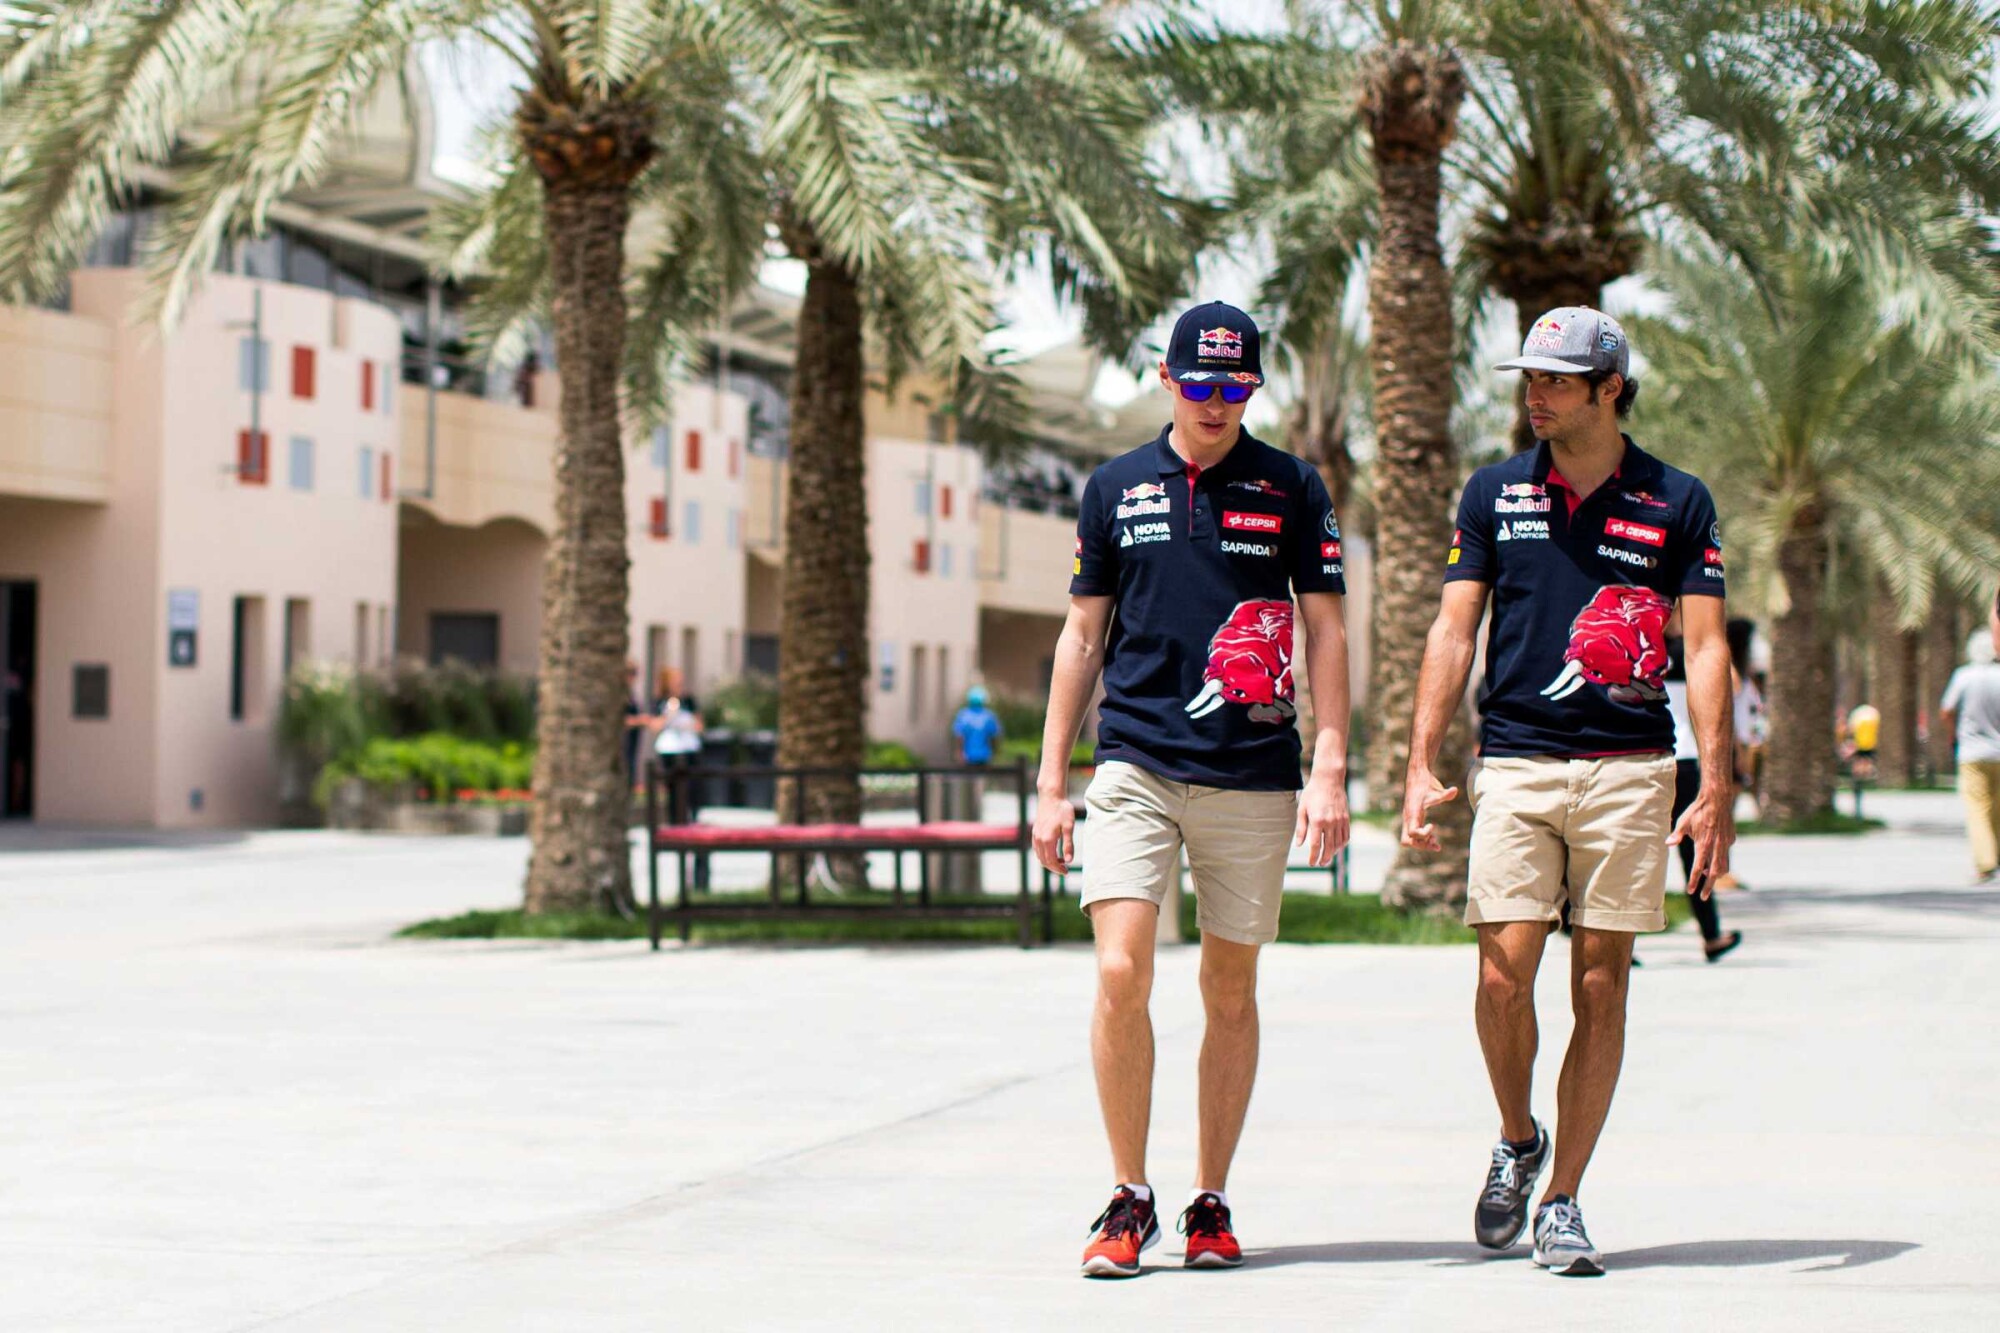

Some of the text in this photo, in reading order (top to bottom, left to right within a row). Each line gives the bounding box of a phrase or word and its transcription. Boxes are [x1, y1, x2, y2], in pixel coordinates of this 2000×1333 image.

[1134, 522, 1171, 536] NOVA
[1512, 520, 1550, 532] NOVA
[1134, 532, 1171, 544] Chemicals
[1512, 531, 1550, 540] Chemicals
[1221, 540, 1271, 557] SAPINDA
[1597, 544, 1649, 568] SAPINDA
